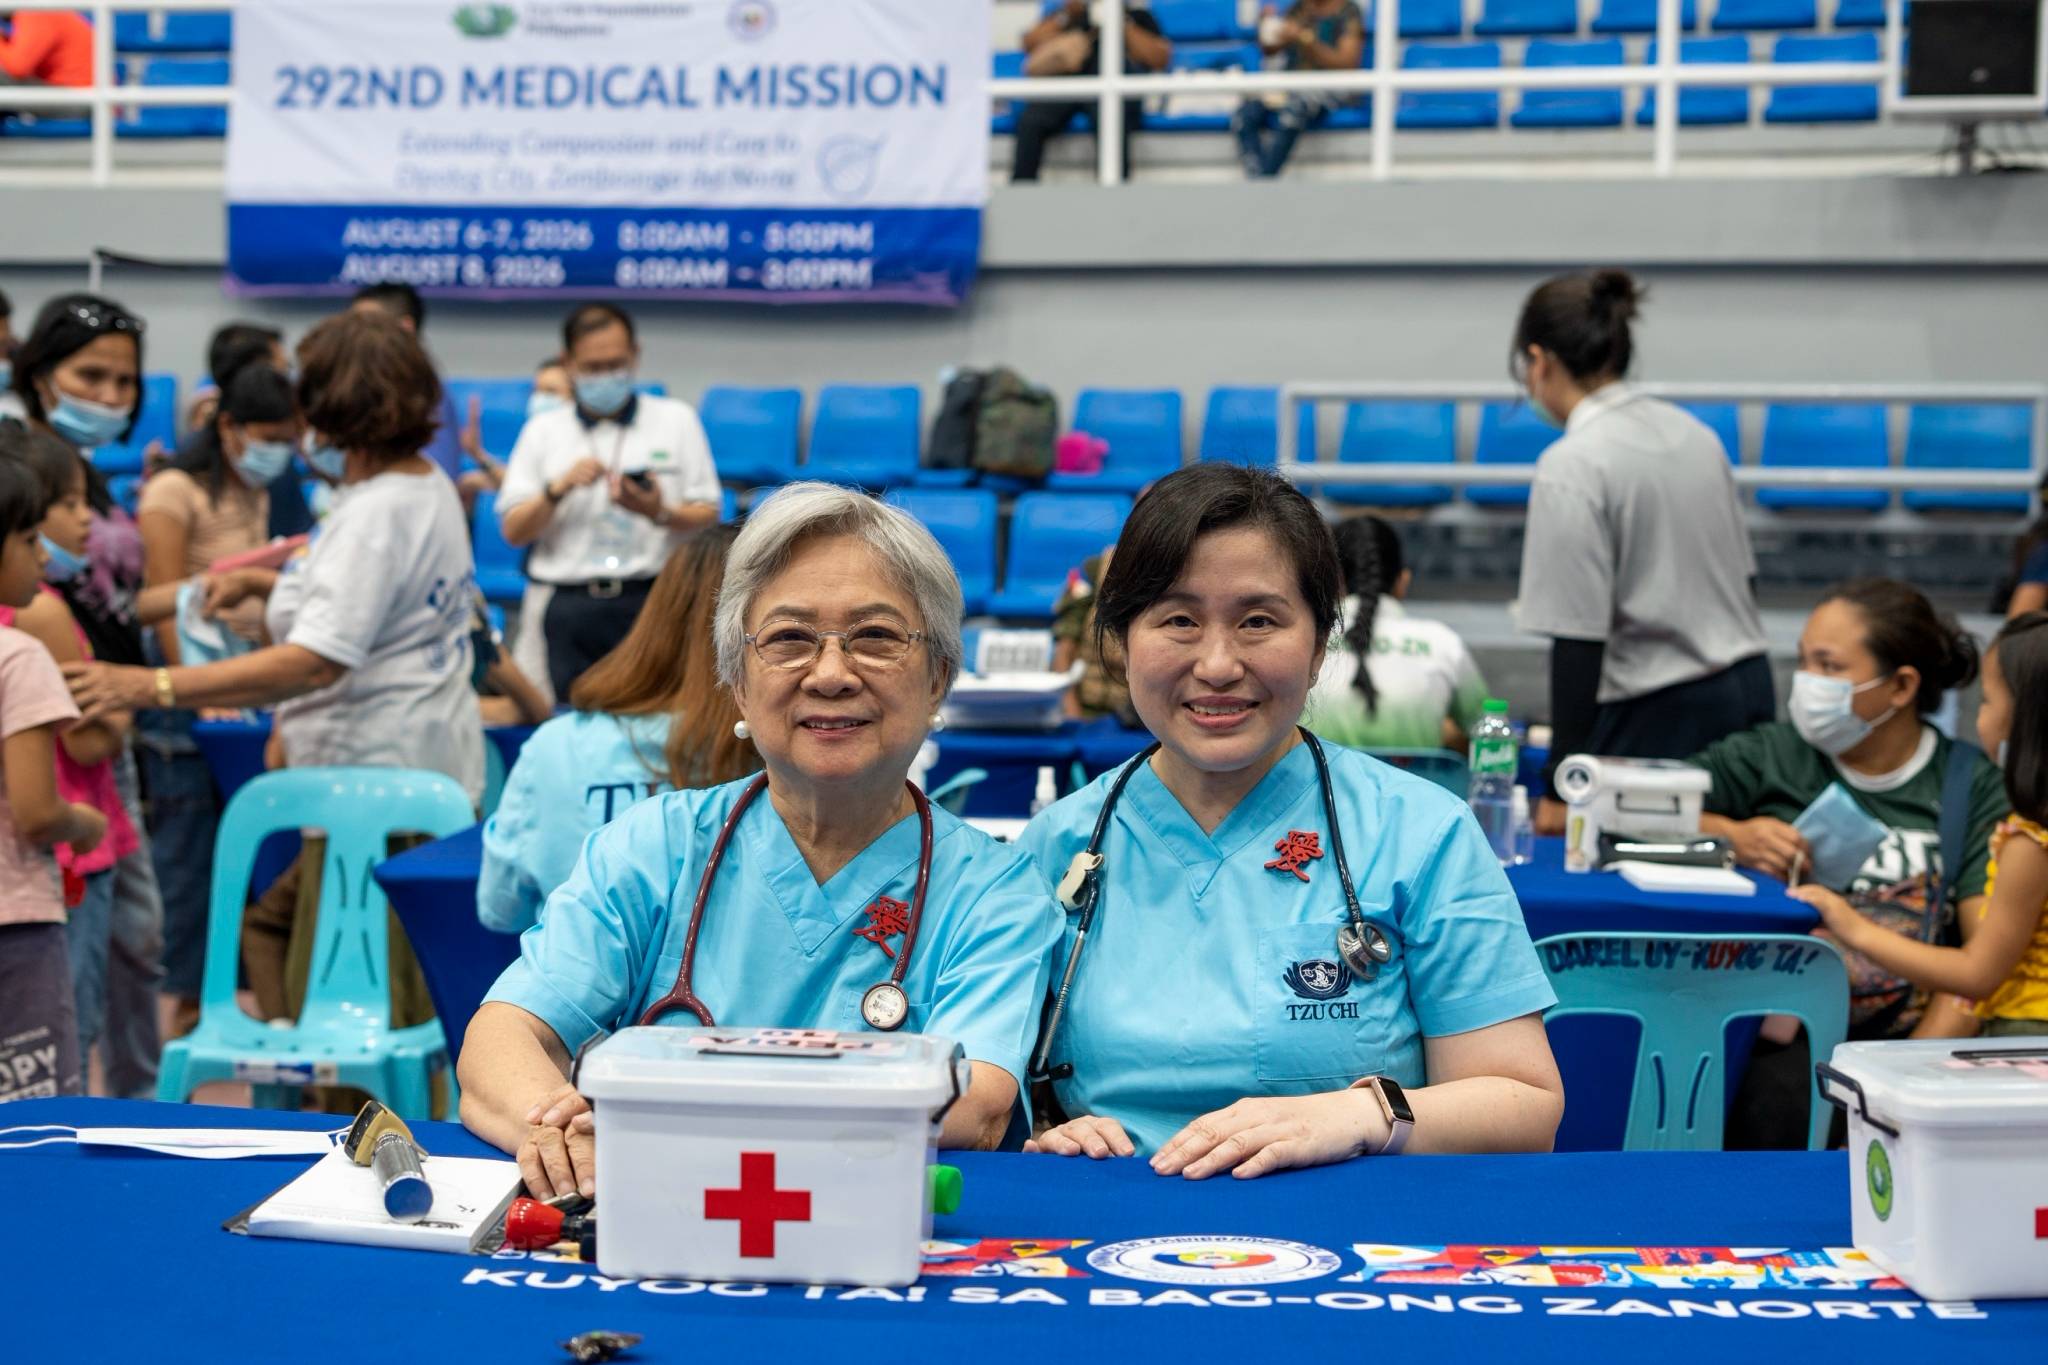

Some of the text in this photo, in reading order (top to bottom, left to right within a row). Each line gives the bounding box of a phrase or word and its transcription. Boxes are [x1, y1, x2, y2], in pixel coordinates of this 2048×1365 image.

[275, 63, 946, 108] 292ND MEDICAL MISSION
[343, 218, 461, 249] AUGUST
[340, 254, 461, 286] AUGUST
[1549, 938, 1640, 973] DAREL
[1286, 1002, 1360, 1020] TZU CHI
[462, 1268, 769, 1296] KUYOG
[949, 1287, 1068, 1305] SA
[1089, 1289, 1523, 1313] BAG-ONG
[1542, 1298, 1988, 1318] ZANORTE
